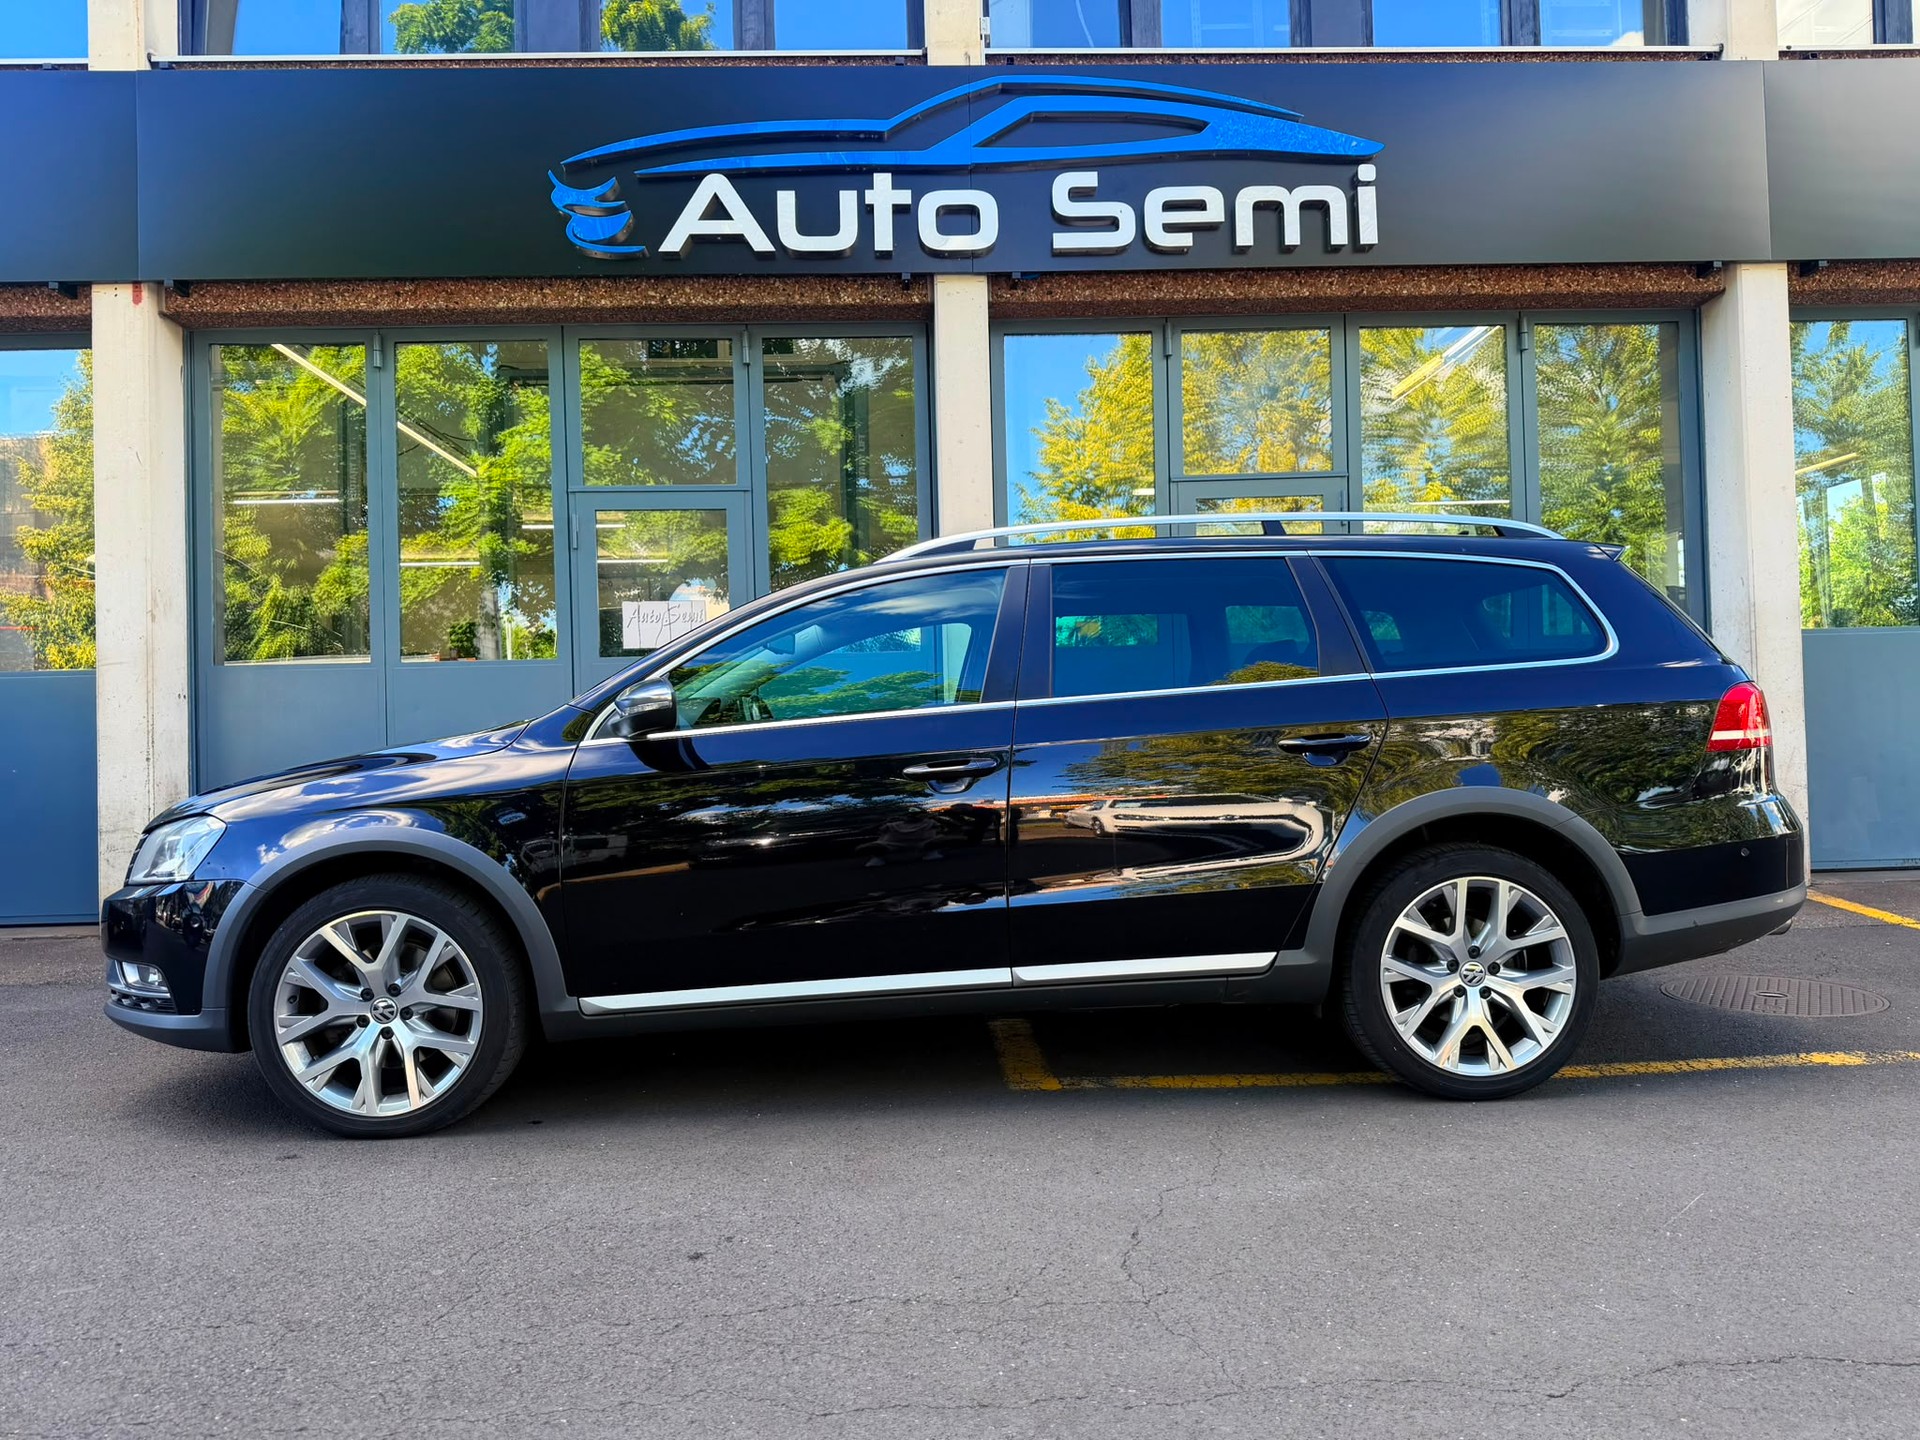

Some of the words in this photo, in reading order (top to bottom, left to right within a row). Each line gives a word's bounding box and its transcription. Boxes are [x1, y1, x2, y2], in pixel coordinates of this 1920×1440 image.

[659, 173, 999, 252] Auto
[1052, 163, 1379, 250] Semi
[349, 442, 357, 460] LIFT
[858, 434, 866, 451] LIFT
